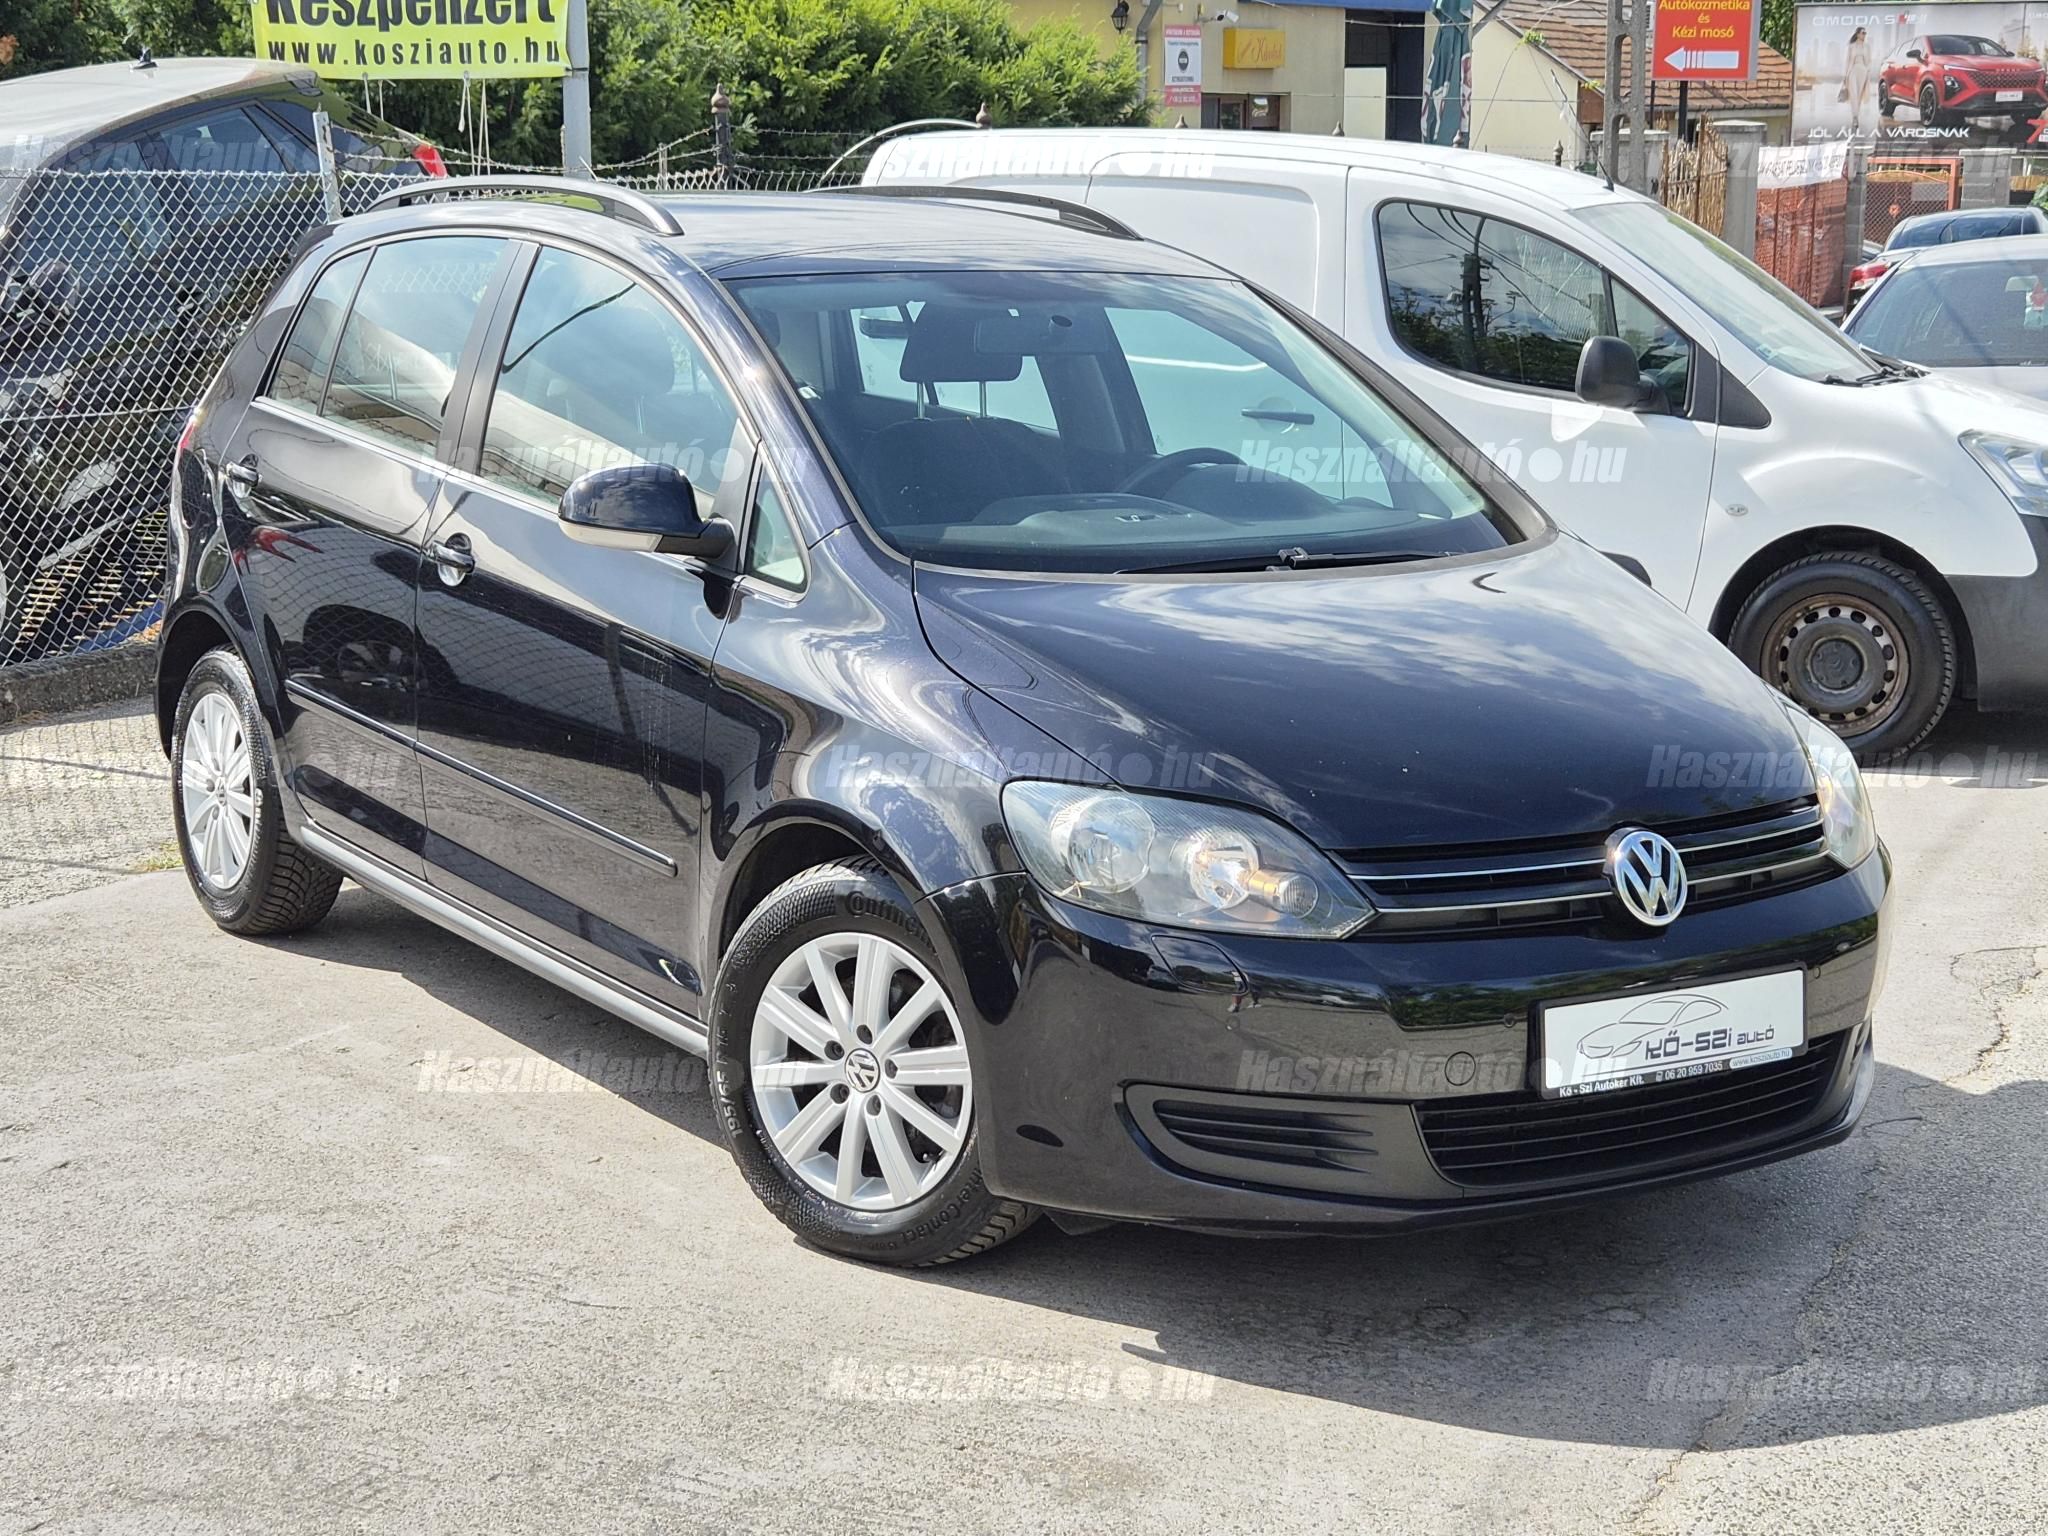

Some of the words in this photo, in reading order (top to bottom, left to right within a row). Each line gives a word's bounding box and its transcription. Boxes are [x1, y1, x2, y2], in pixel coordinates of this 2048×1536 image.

[1698, 13, 1710, 24] és
[1812, 15, 1880, 26] OMODA
[1672, 25, 1697, 38] Kézi
[1701, 25, 1735, 38] mosó
[268, 37, 560, 65] www.kosziauto.hu
[1807, 126, 1832, 138] JÓL
[1887, 125, 1970, 138] VÁROSNAK
[1665, 1069, 1676, 1080] 06
[1677, 1068, 1687, 1078] 20
[1704, 1062, 1723, 1074] 7035
